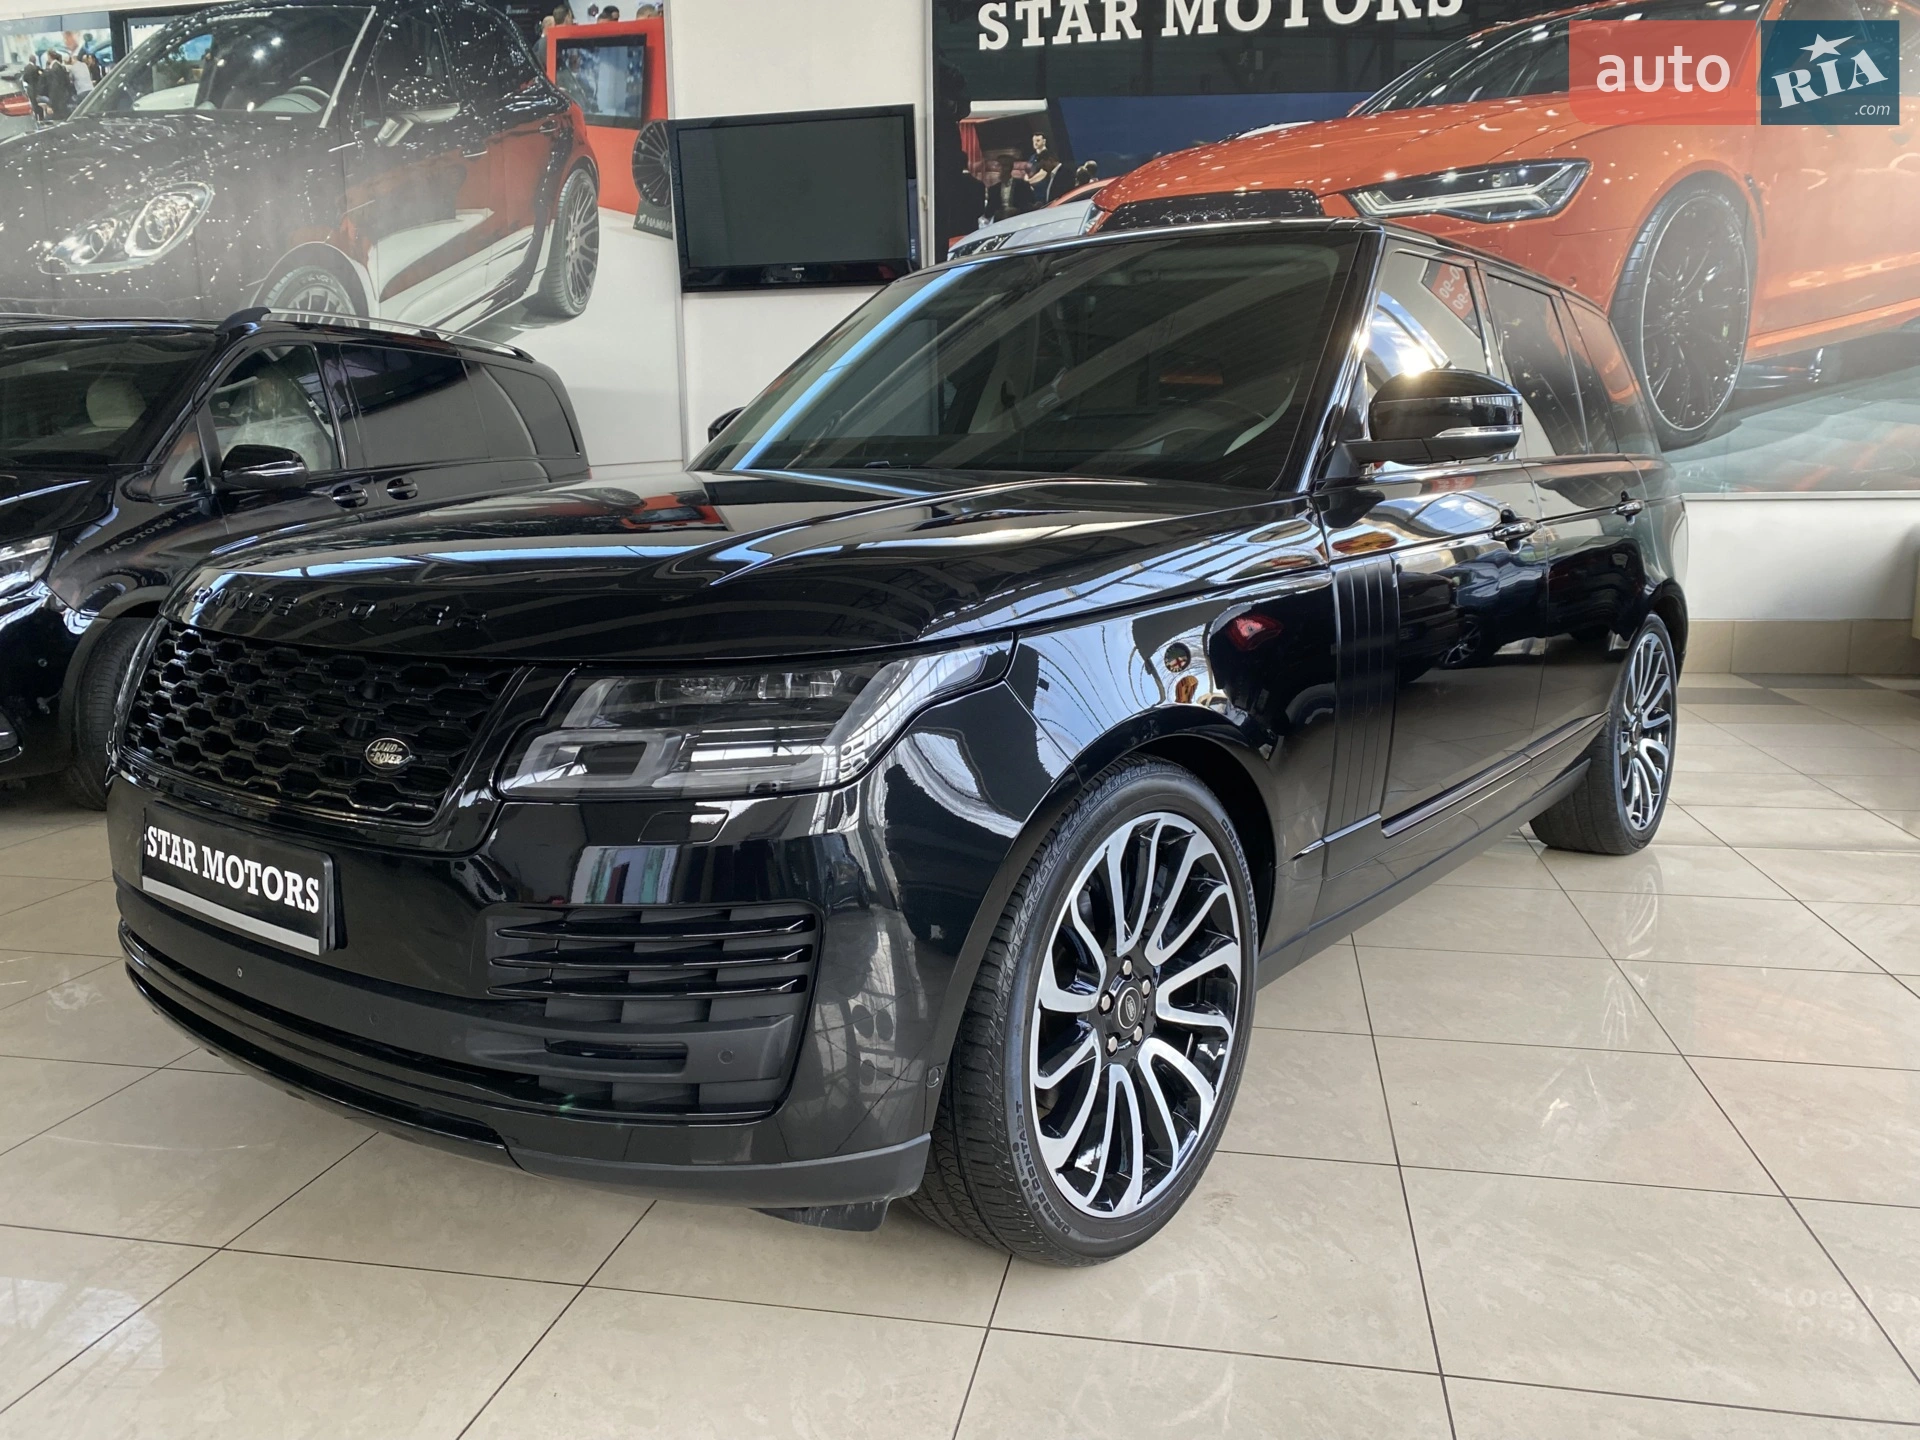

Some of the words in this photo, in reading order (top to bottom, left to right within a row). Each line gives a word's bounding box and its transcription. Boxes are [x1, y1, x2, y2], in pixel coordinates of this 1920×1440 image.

[978, 0, 1142, 50] STAR
[192, 586, 299, 617] RANGE
[318, 598, 488, 630] ROVER
[373, 741, 399, 752] LAND
[373, 751, 403, 765] ROVER
[146, 825, 198, 875] STAR
[201, 845, 320, 914] MOTORS
